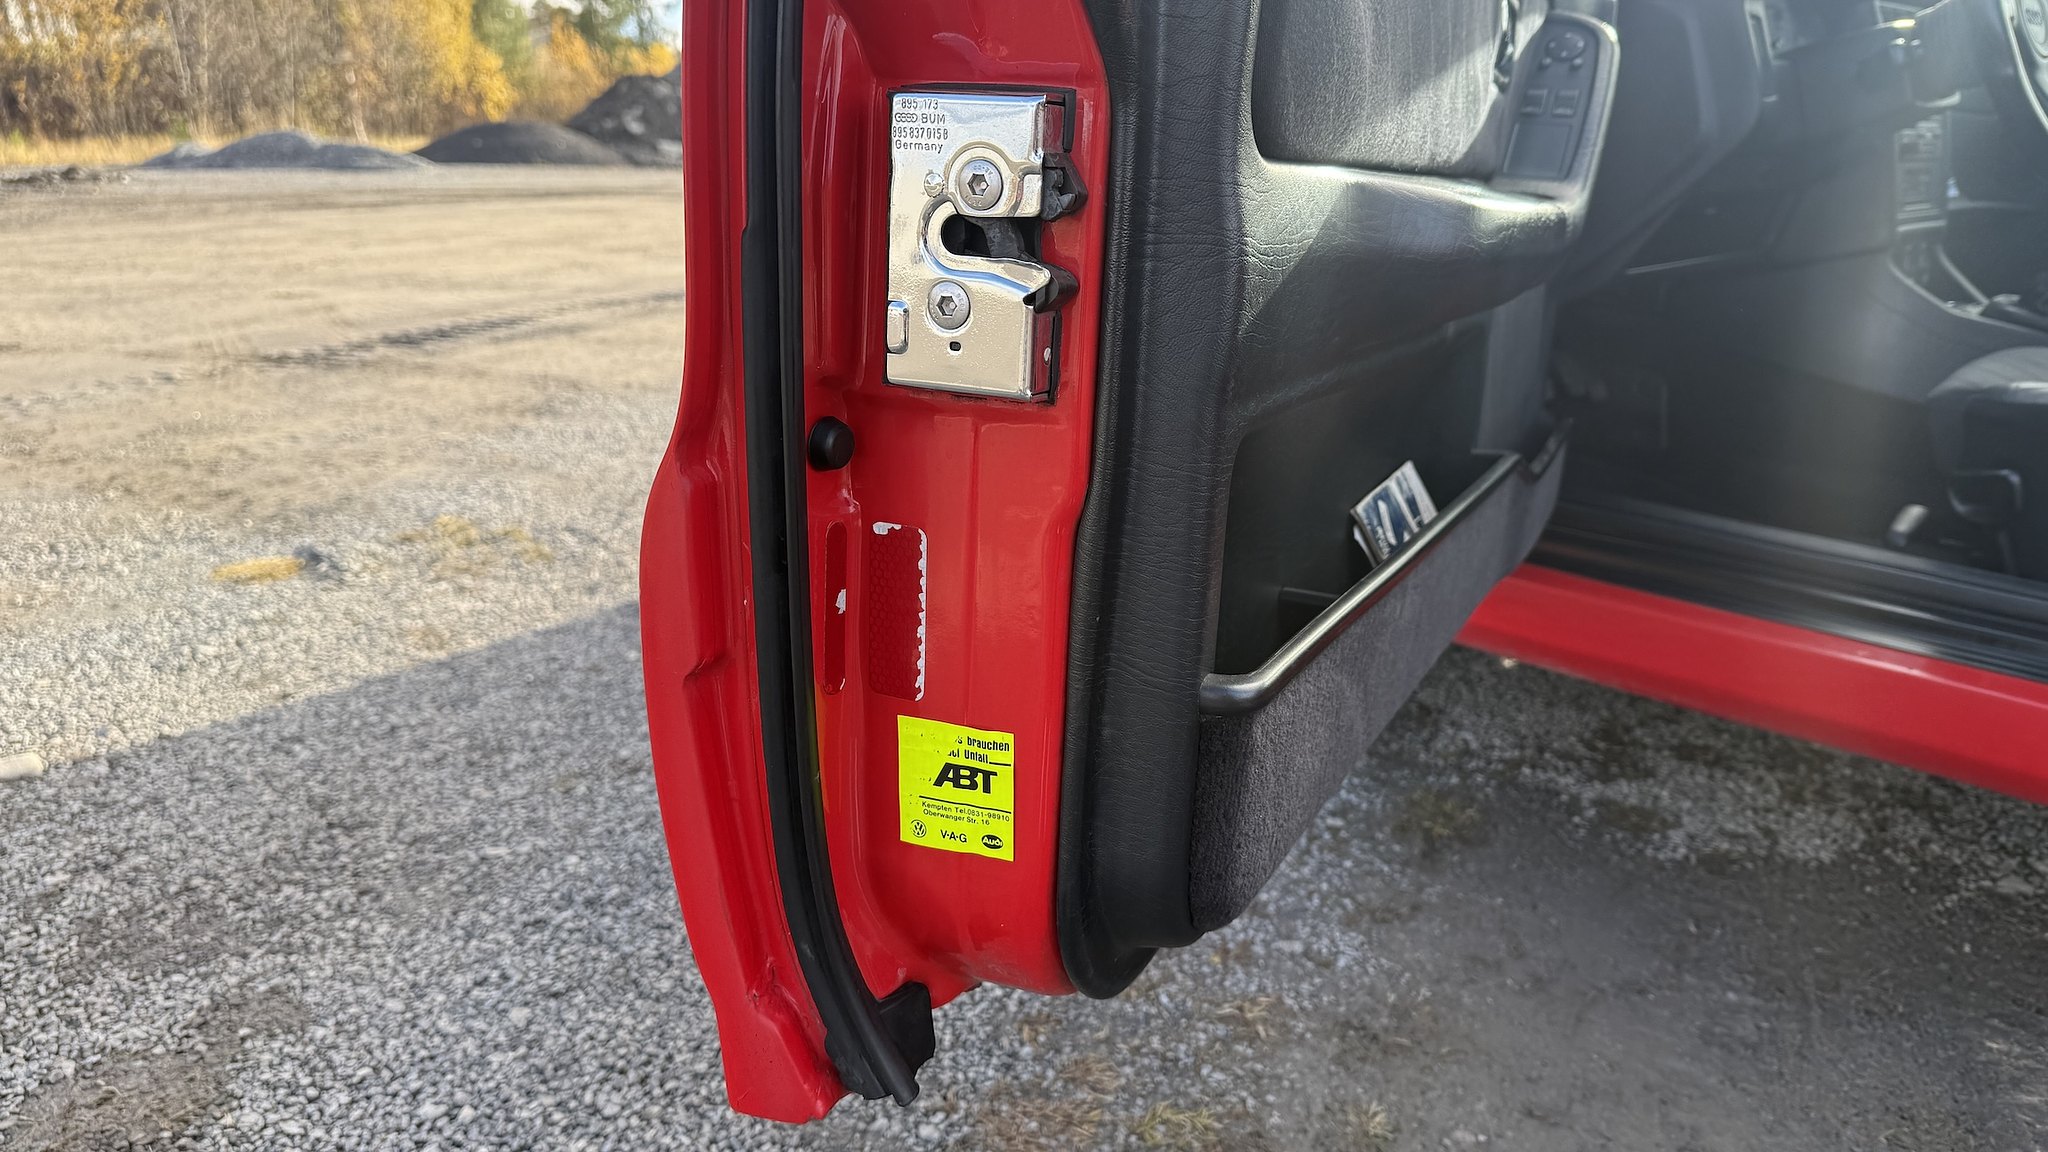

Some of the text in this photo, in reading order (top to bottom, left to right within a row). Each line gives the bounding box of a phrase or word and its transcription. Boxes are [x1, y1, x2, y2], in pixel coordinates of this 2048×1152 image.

[901, 98, 939, 110] 895 173
[921, 113, 946, 125] BUM
[895, 140, 943, 154] Germany
[967, 736, 1010, 752] brauchen
[933, 762, 998, 794] ABT
[922, 801, 952, 812] Kempten
[923, 808, 990, 826] Oberwanger Str. 16
